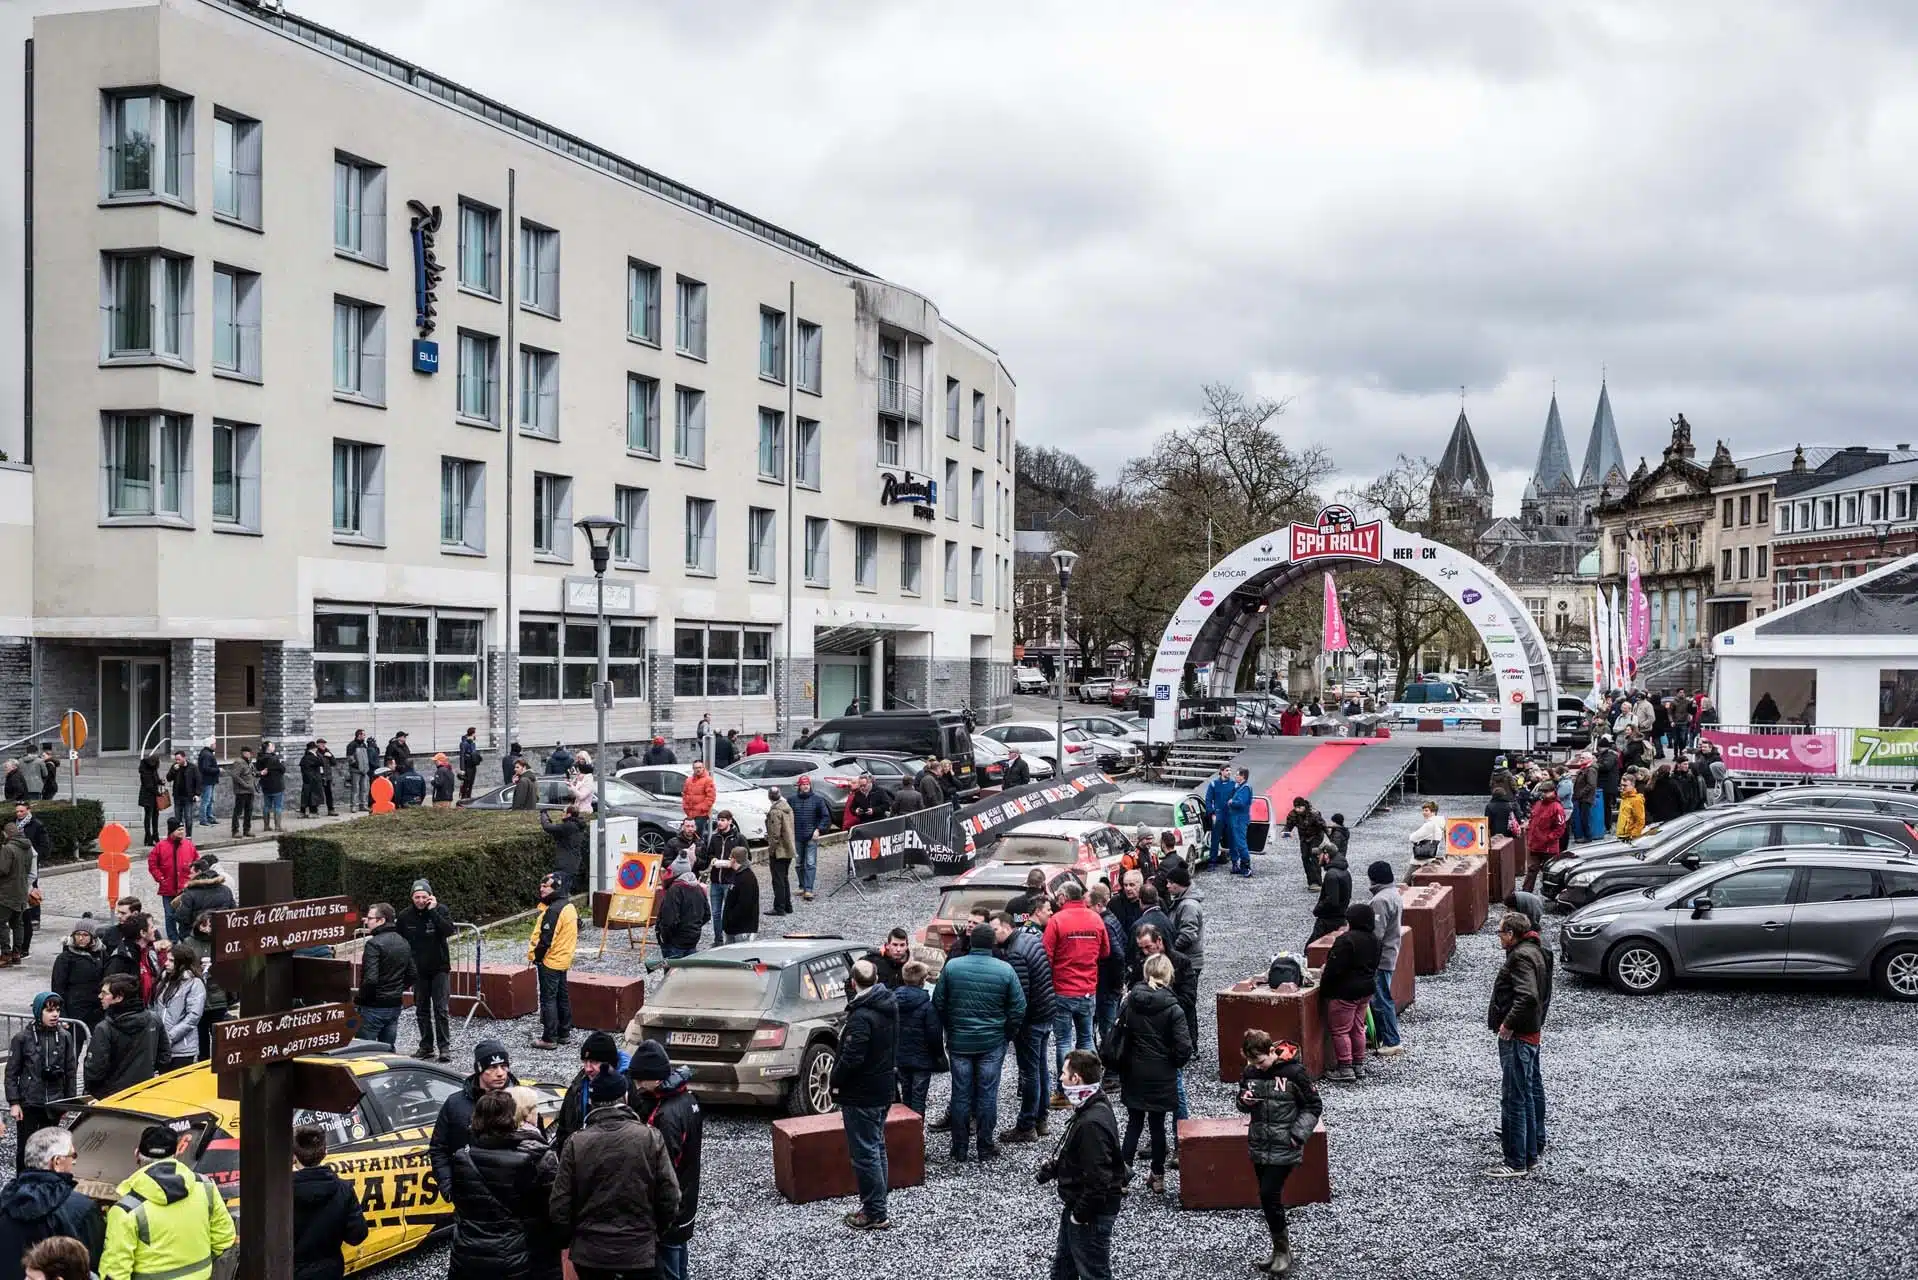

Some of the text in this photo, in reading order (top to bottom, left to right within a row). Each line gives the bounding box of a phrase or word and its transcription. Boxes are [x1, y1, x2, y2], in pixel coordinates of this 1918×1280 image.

[419, 352, 437, 363] BLU
[1296, 530, 1374, 555] SPA RALLY
[1212, 570, 1247, 578] EMOCAR
[1439, 567, 1459, 580] Spa
[1728, 742, 1790, 760] deux
[226, 912, 249, 929] Vers
[253, 910, 265, 925] la
[225, 926, 345, 953] O.T. SPA 087/795353
[225, 1009, 345, 1039] Vers les Artistes 7Km
[672, 1033, 717, 1044] 1-VFH-728
[227, 1032, 341, 1065] O.T. SPA 087/795353
[1273, 1076, 1287, 1092] N
[328, 1154, 432, 1174] ONTAINER
[360, 1171, 439, 1213] AES
